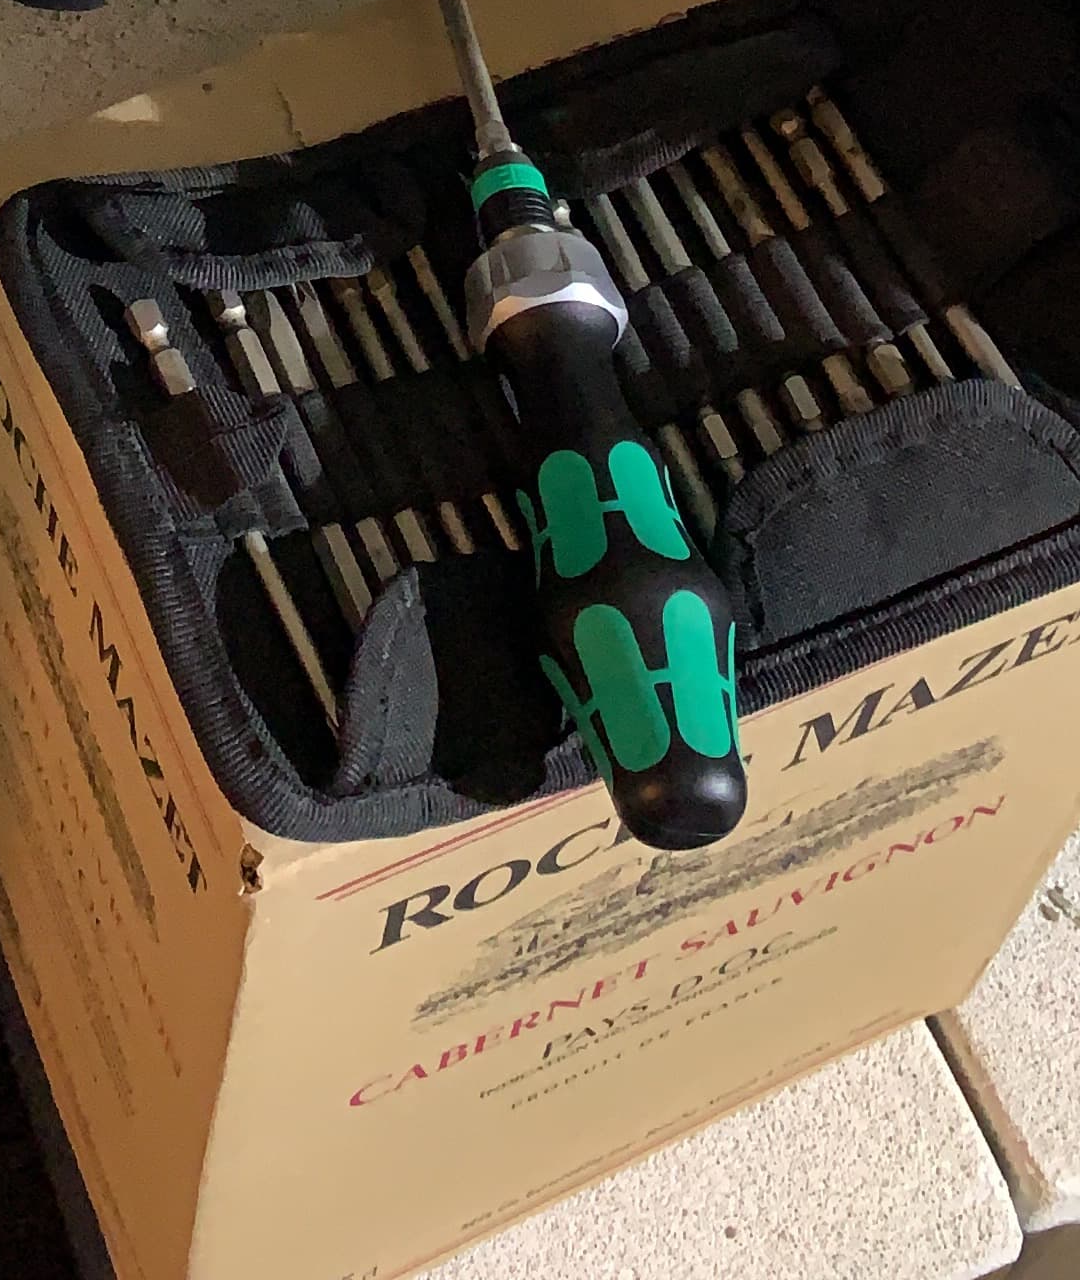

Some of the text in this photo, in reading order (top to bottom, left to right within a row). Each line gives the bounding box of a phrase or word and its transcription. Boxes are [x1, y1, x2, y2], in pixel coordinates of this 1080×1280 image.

[781, 607, 1080, 772] MAZE
[349, 954, 661, 1108] CABERNET
[675, 795, 1006, 962] SAUVIGNON
[542, 997, 650, 1060] PAYS
